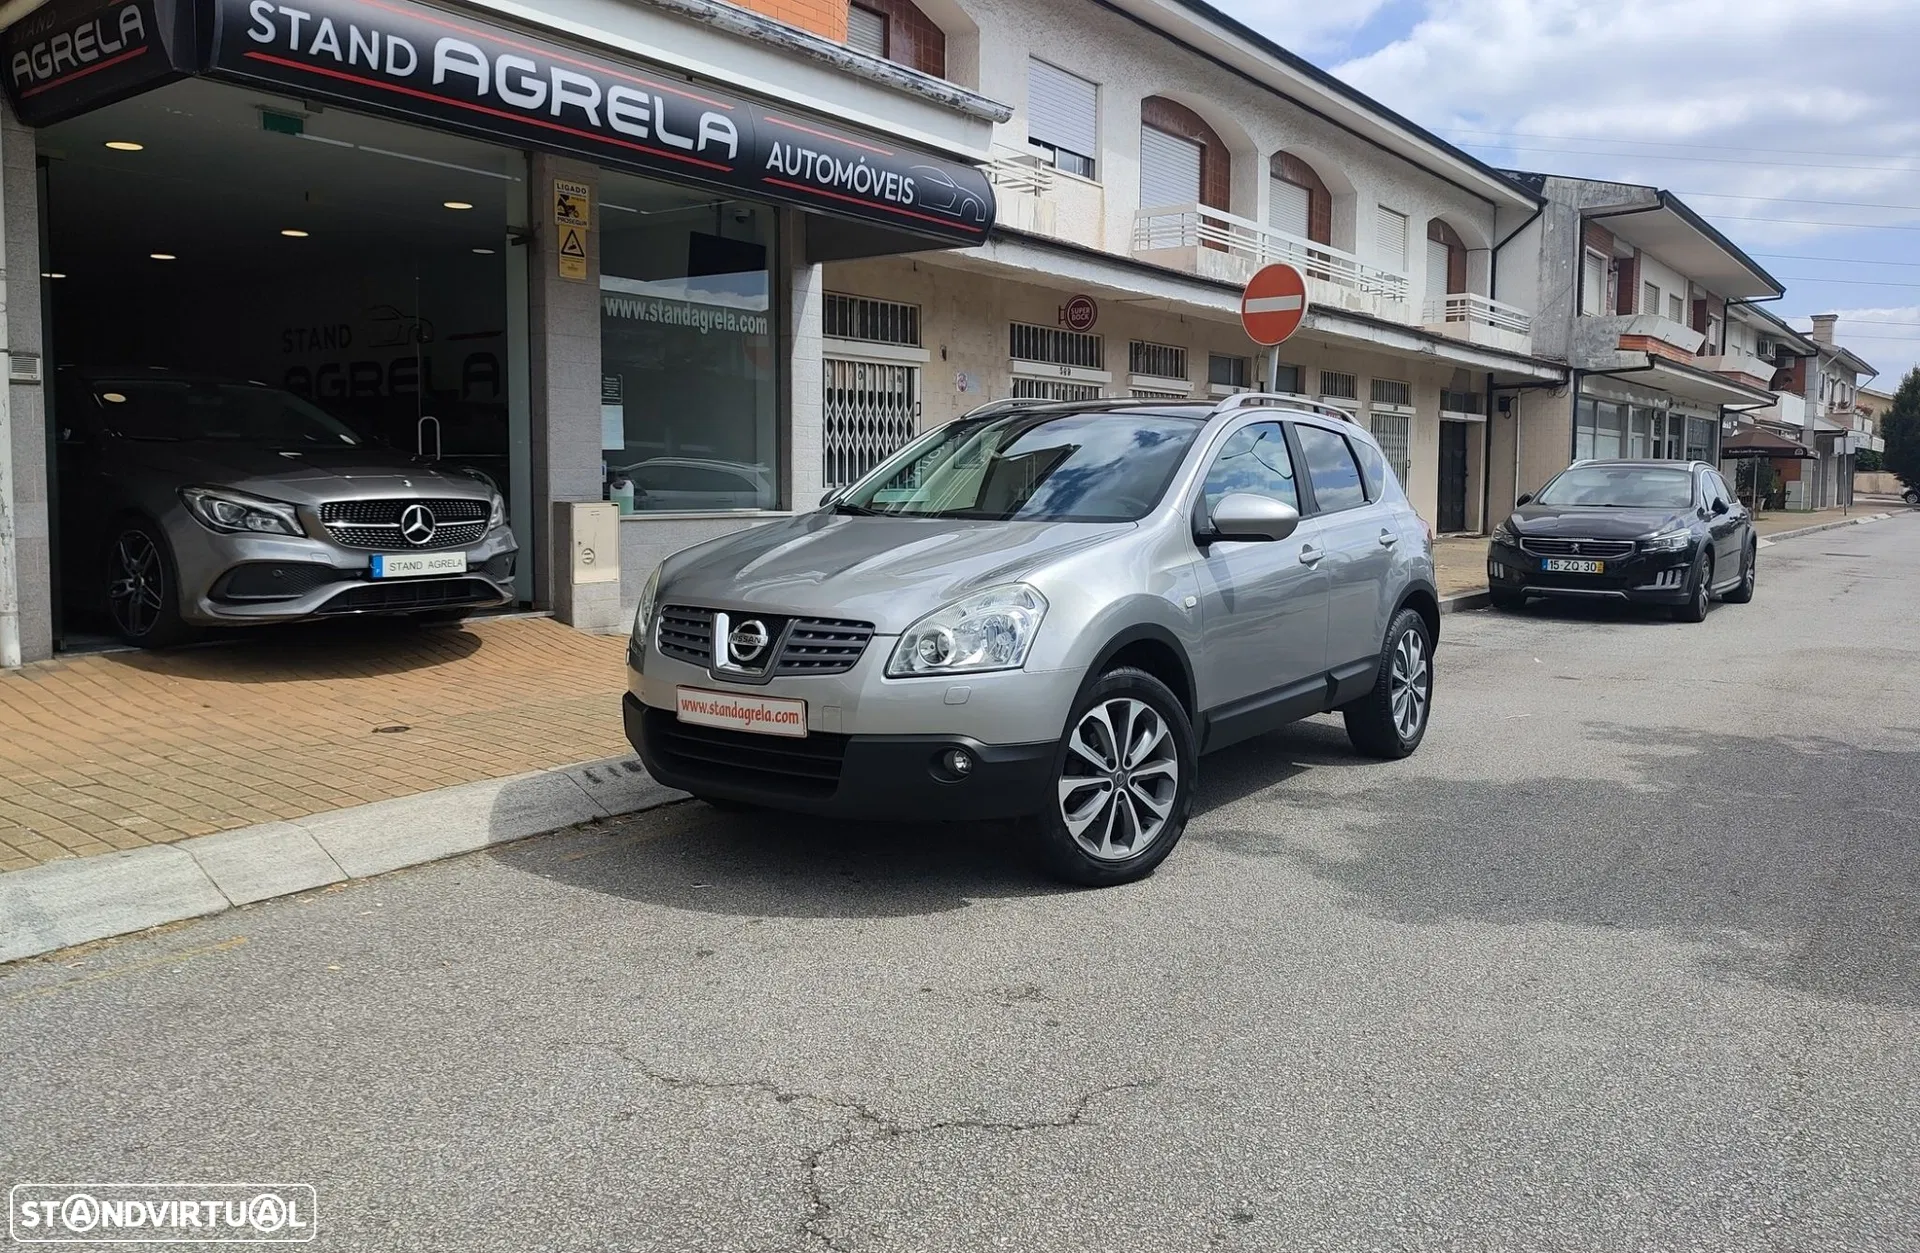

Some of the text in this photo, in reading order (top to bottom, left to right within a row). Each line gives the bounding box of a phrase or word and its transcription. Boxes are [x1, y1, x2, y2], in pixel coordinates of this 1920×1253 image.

[12, 4, 145, 88] AGRELA
[247, 0, 914, 204] STAND AGRELA AUTOMÓVEIS
[556, 182, 587, 194] LIGADO
[604, 297, 768, 335] www.standagrela.com
[1071, 306, 1090, 315] SUPER
[1071, 313, 1090, 321] BOCK
[282, 323, 353, 354] STAND
[284, 352, 501, 401] AGRELA
[389, 560, 423, 572] STAND
[428, 558, 463, 569] AGRELA
[731, 634, 761, 645] NISSAN
[681, 699, 799, 725] www.standagrela.com
